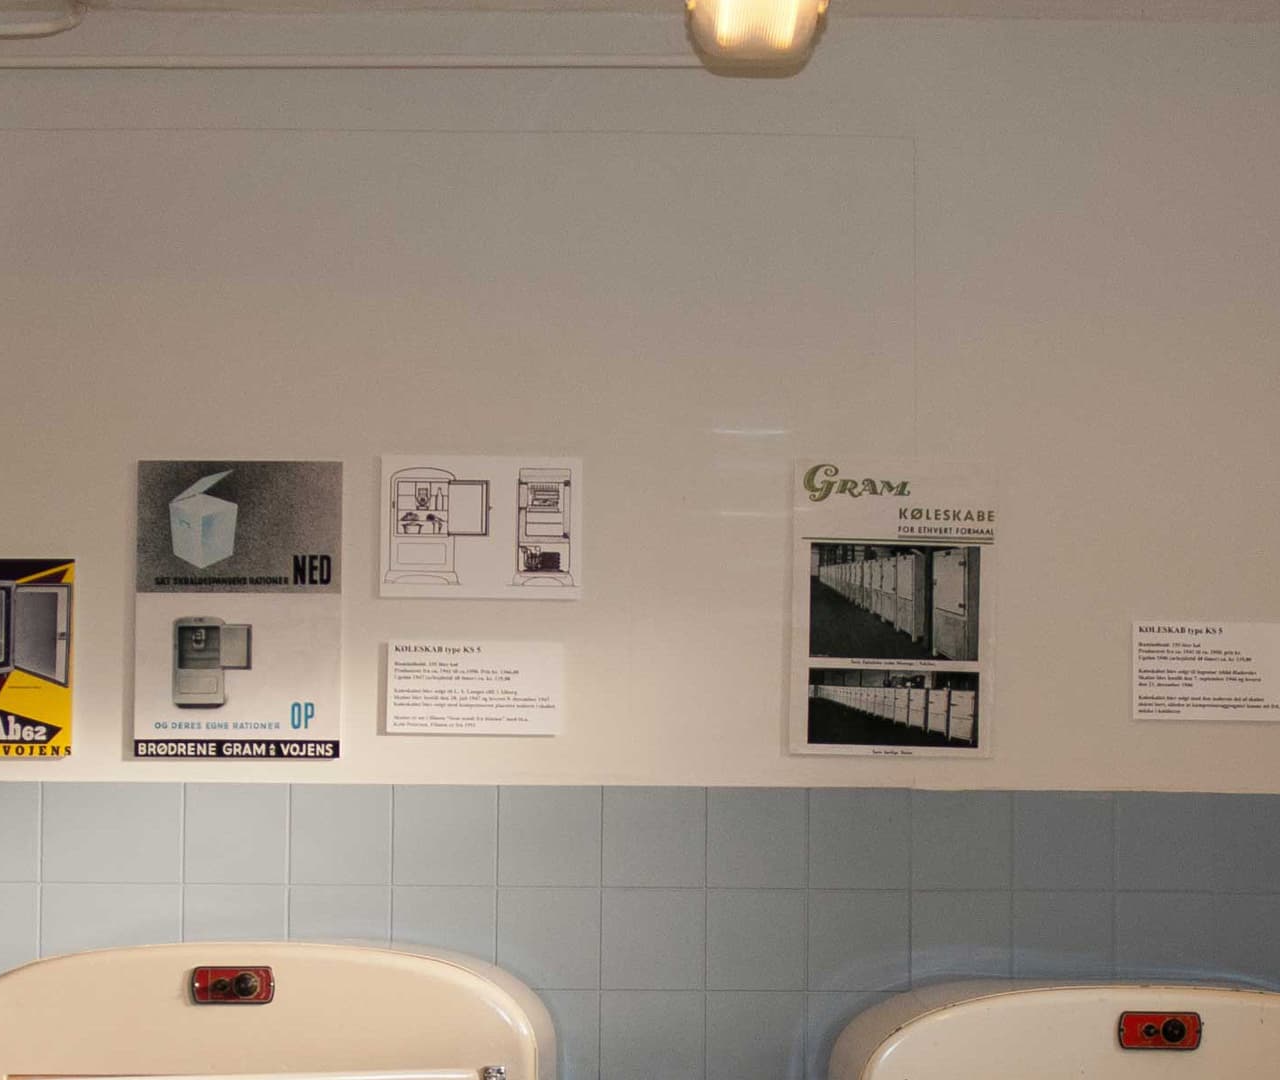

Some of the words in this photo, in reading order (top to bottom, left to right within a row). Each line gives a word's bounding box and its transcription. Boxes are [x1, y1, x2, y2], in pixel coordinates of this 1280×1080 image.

[803, 463, 911, 502] GRAM
[898, 507, 996, 522] KØLESKABE
[897, 526, 915, 534] FOR
[917, 527, 953, 535] ETHVERT
[955, 528, 994, 536] FORMAAL
[292, 555, 332, 586] NED
[1187, 627, 1203, 635] type
[1205, 627, 1217, 635] KS
[444, 647, 461, 655] type
[232, 722, 280, 730] RATIONER
[290, 702, 315, 729] OP
[3, 745, 72, 756] VOJENS
[137, 743, 216, 755] BRØDRENE
[222, 743, 266, 755] GRAM
[280, 743, 334, 756] VOJENS
